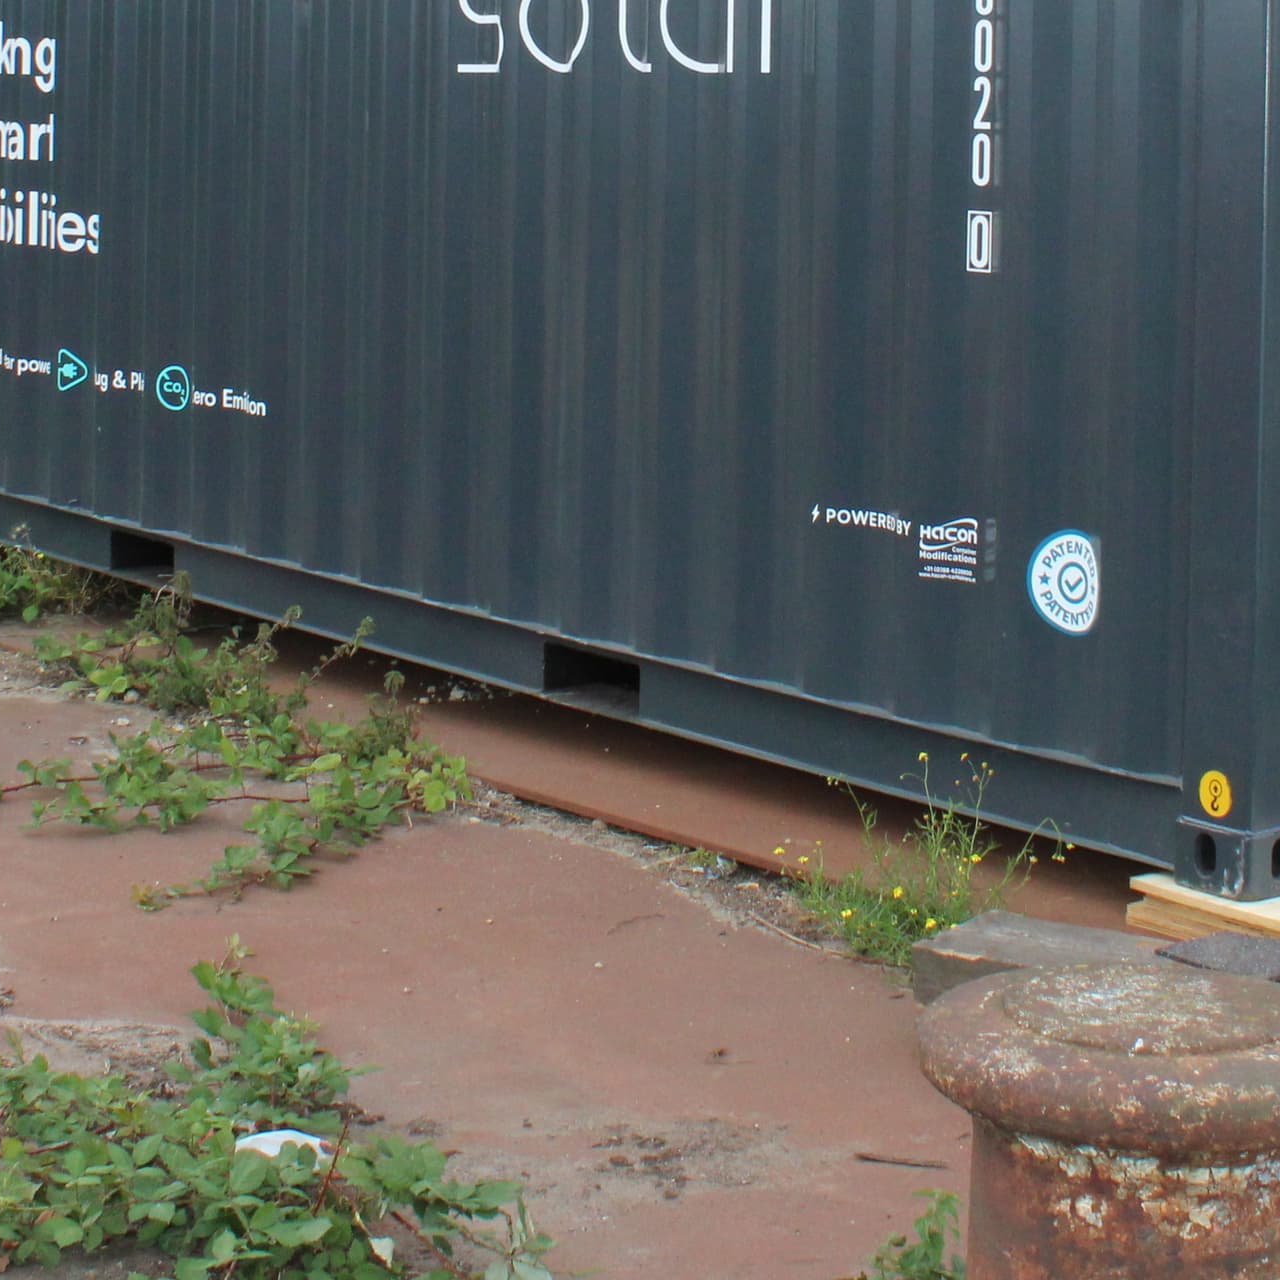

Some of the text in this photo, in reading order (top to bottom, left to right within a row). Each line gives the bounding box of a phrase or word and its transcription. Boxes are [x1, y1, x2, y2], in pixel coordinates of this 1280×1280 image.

[112, 370, 127, 389] &
[192, 385, 217, 407] ero
[896, 519, 911, 537] BY
